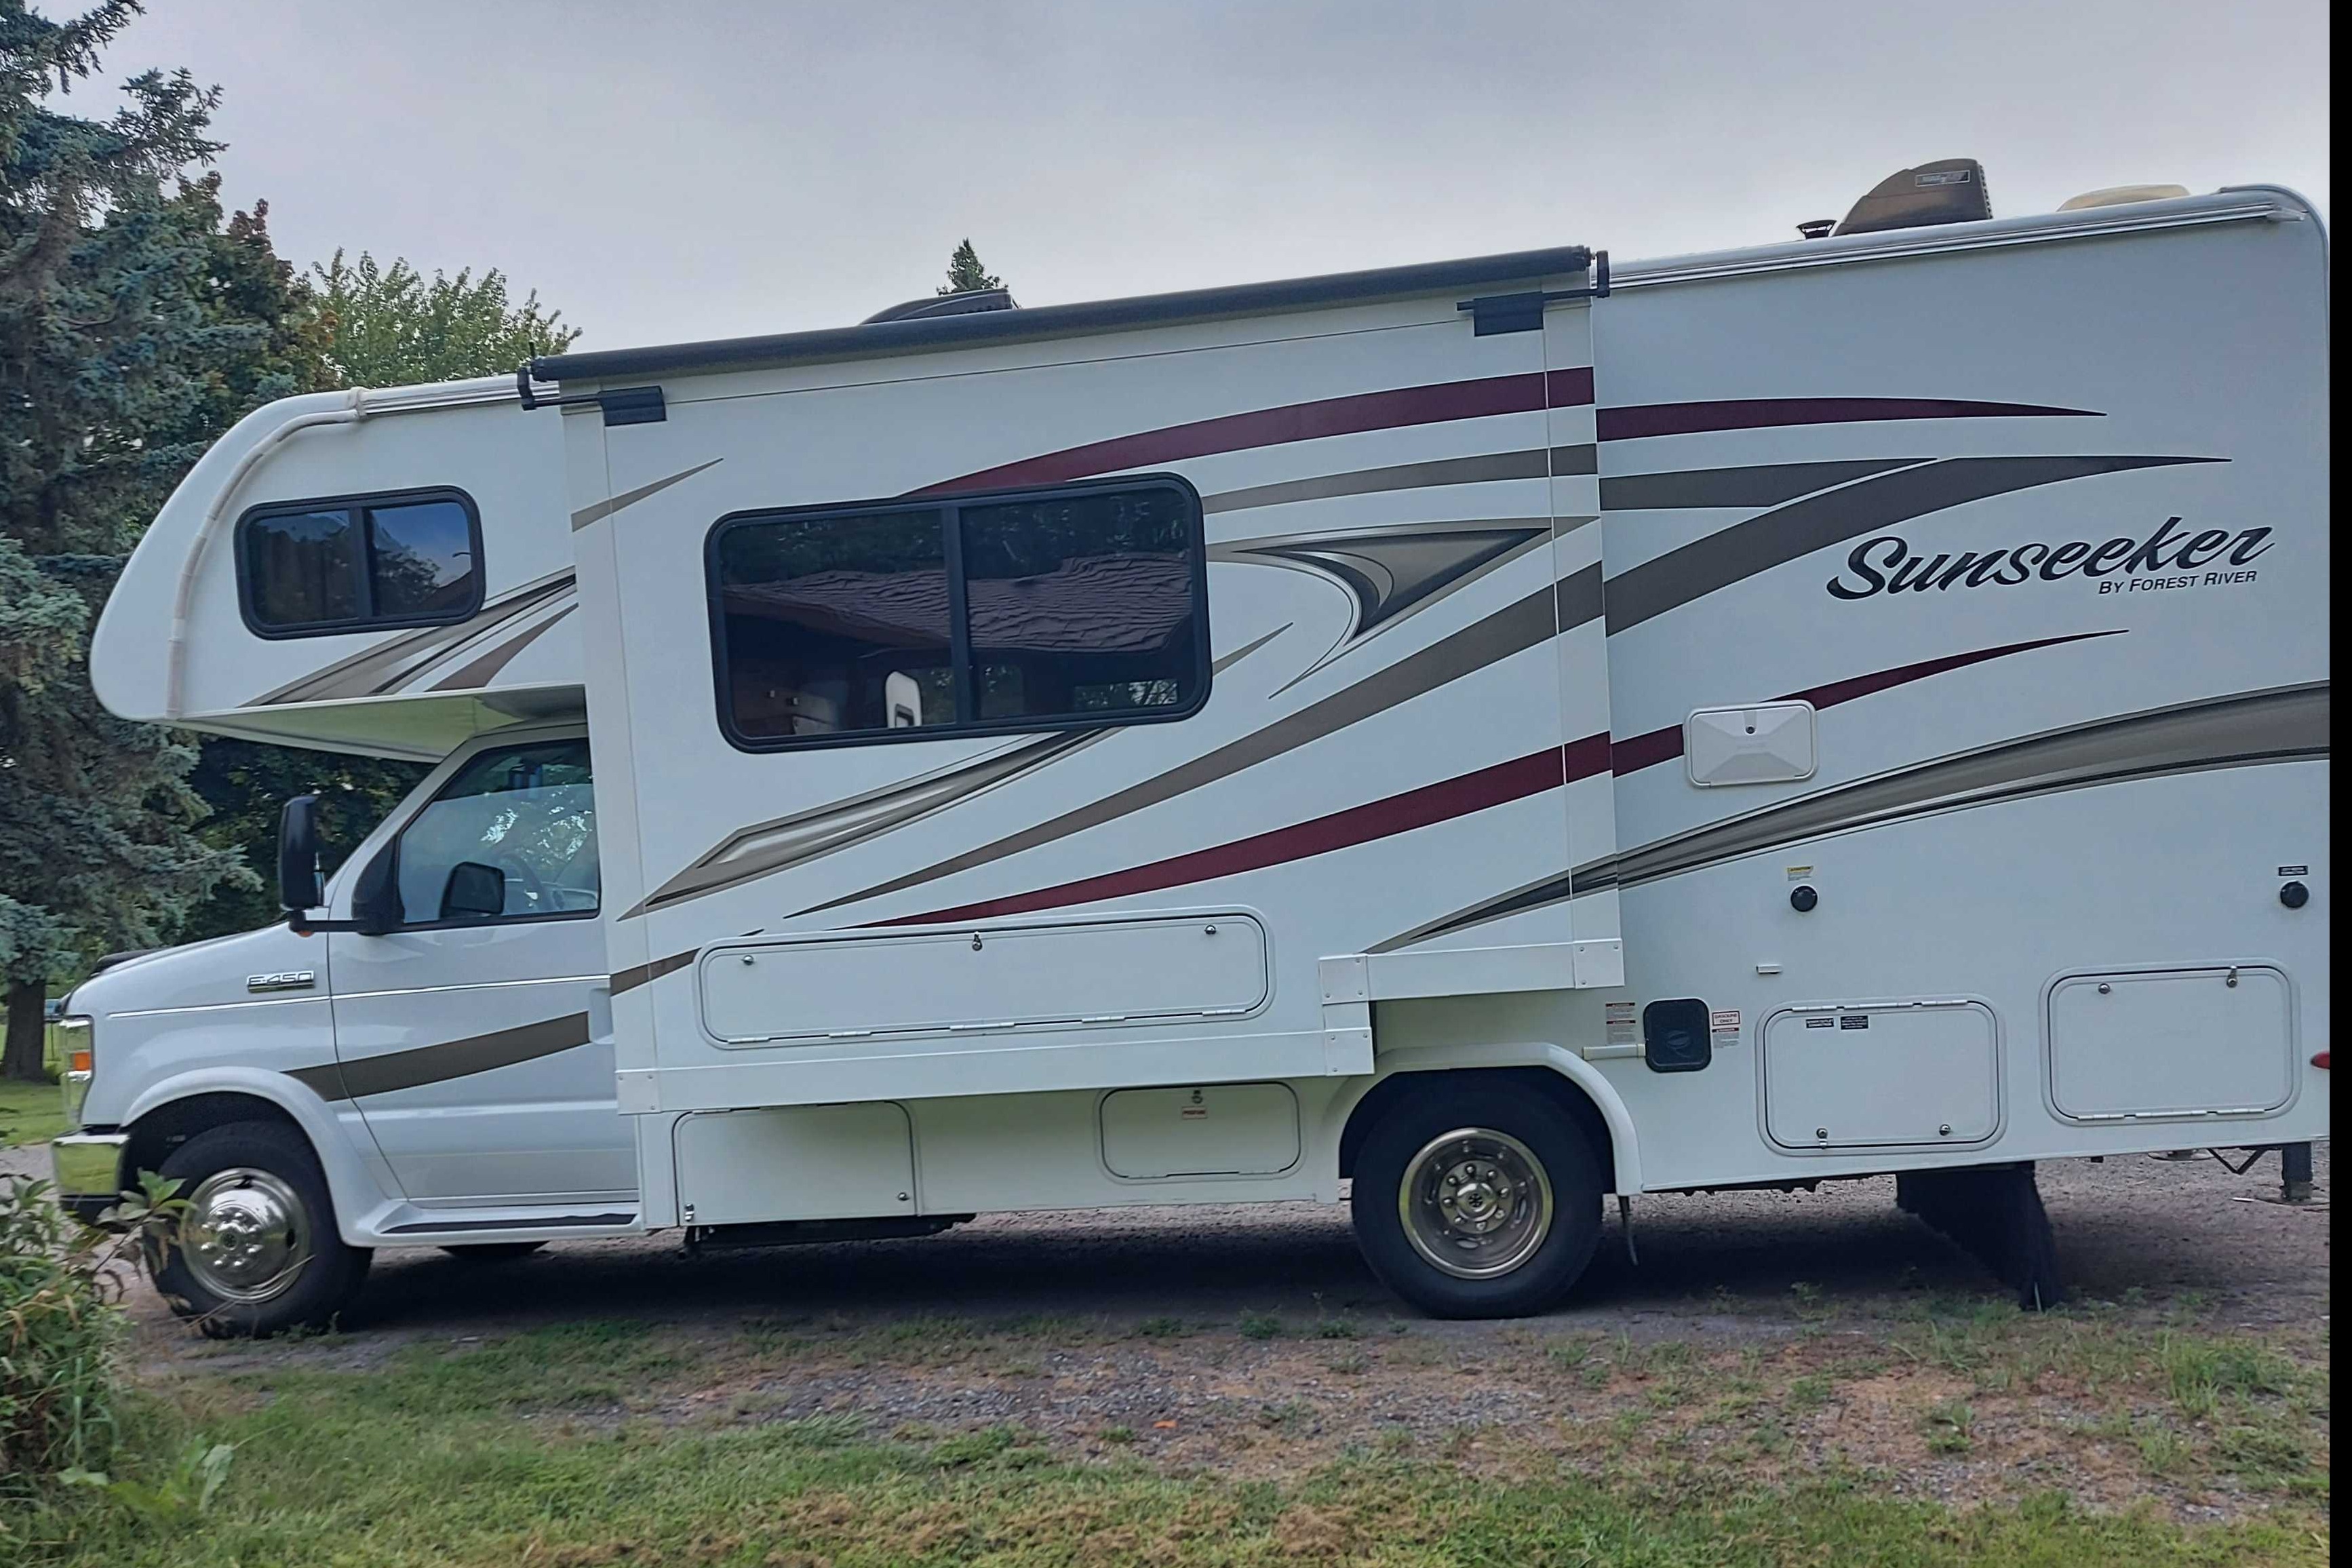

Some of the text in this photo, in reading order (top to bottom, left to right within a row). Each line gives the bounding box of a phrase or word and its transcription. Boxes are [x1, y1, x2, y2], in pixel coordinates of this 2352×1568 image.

[1826, 516, 2276, 600] Sunseeker
[2098, 570, 2257, 594] BY FOREST RIVER
[248, 971, 314, 986] E-450
